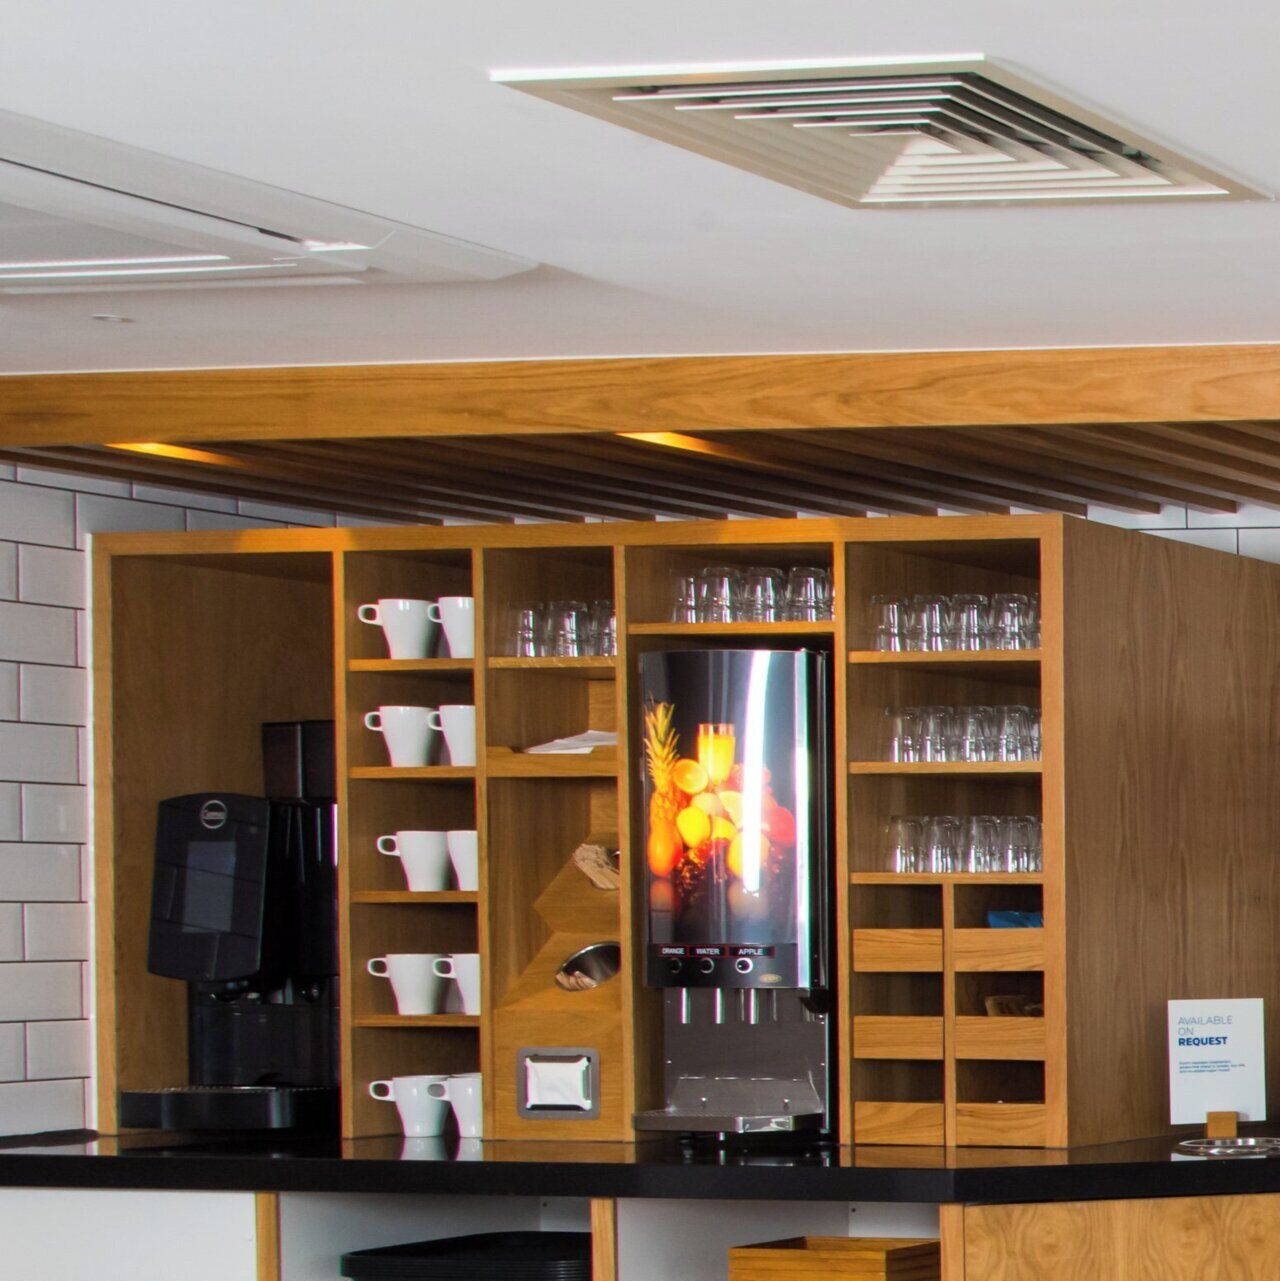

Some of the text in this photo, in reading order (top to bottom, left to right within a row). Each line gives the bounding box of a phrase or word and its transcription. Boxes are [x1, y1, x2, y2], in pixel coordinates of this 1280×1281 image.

[1178, 1015, 1233, 1026] AVAILABLE
[1178, 1026, 1195, 1037] ON
[1178, 1036, 1228, 1047] REQUEST
